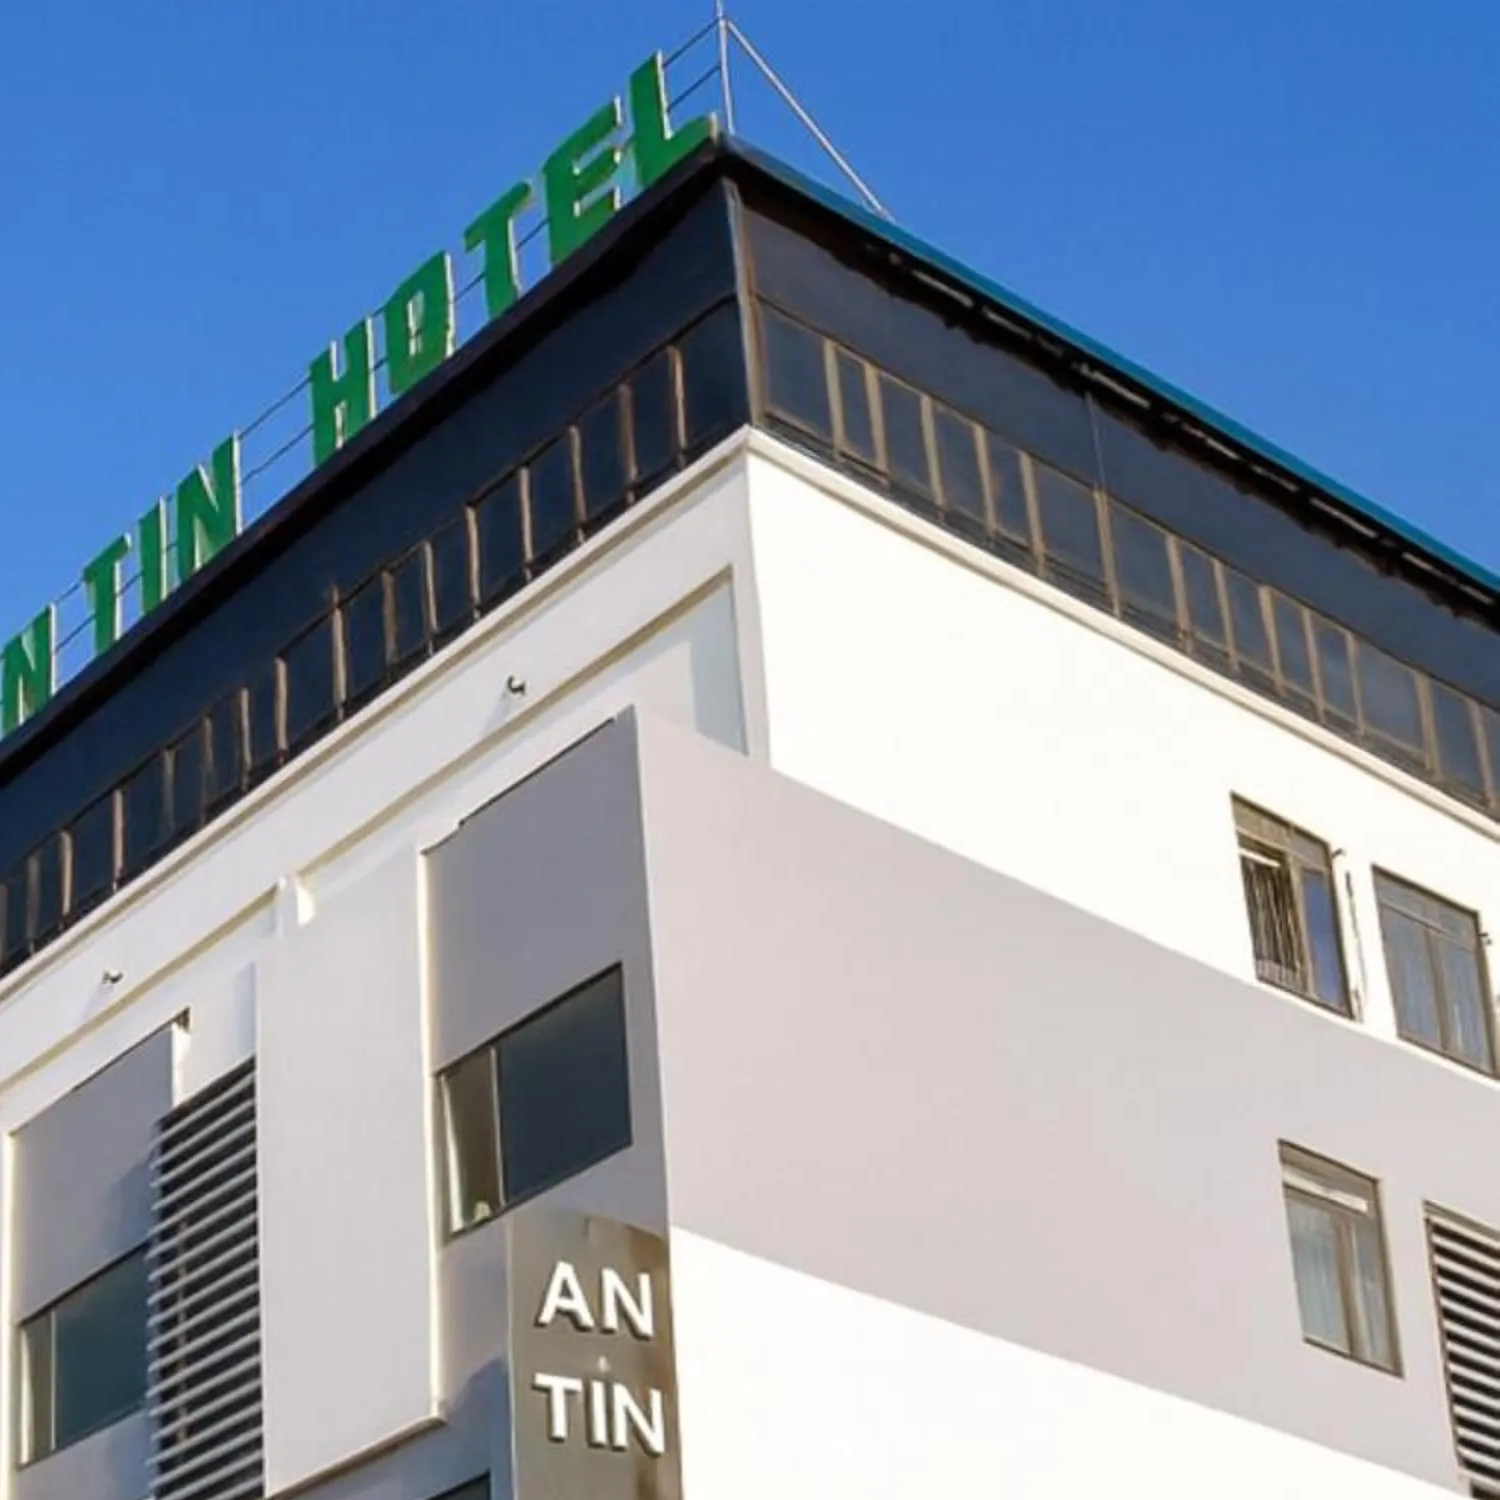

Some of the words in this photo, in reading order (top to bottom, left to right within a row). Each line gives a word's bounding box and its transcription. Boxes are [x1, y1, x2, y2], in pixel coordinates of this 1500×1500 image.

[83, 431, 243, 656] TIN
[309, 49, 719, 469] HOTEL
[534, 1260, 656, 1340] AN
